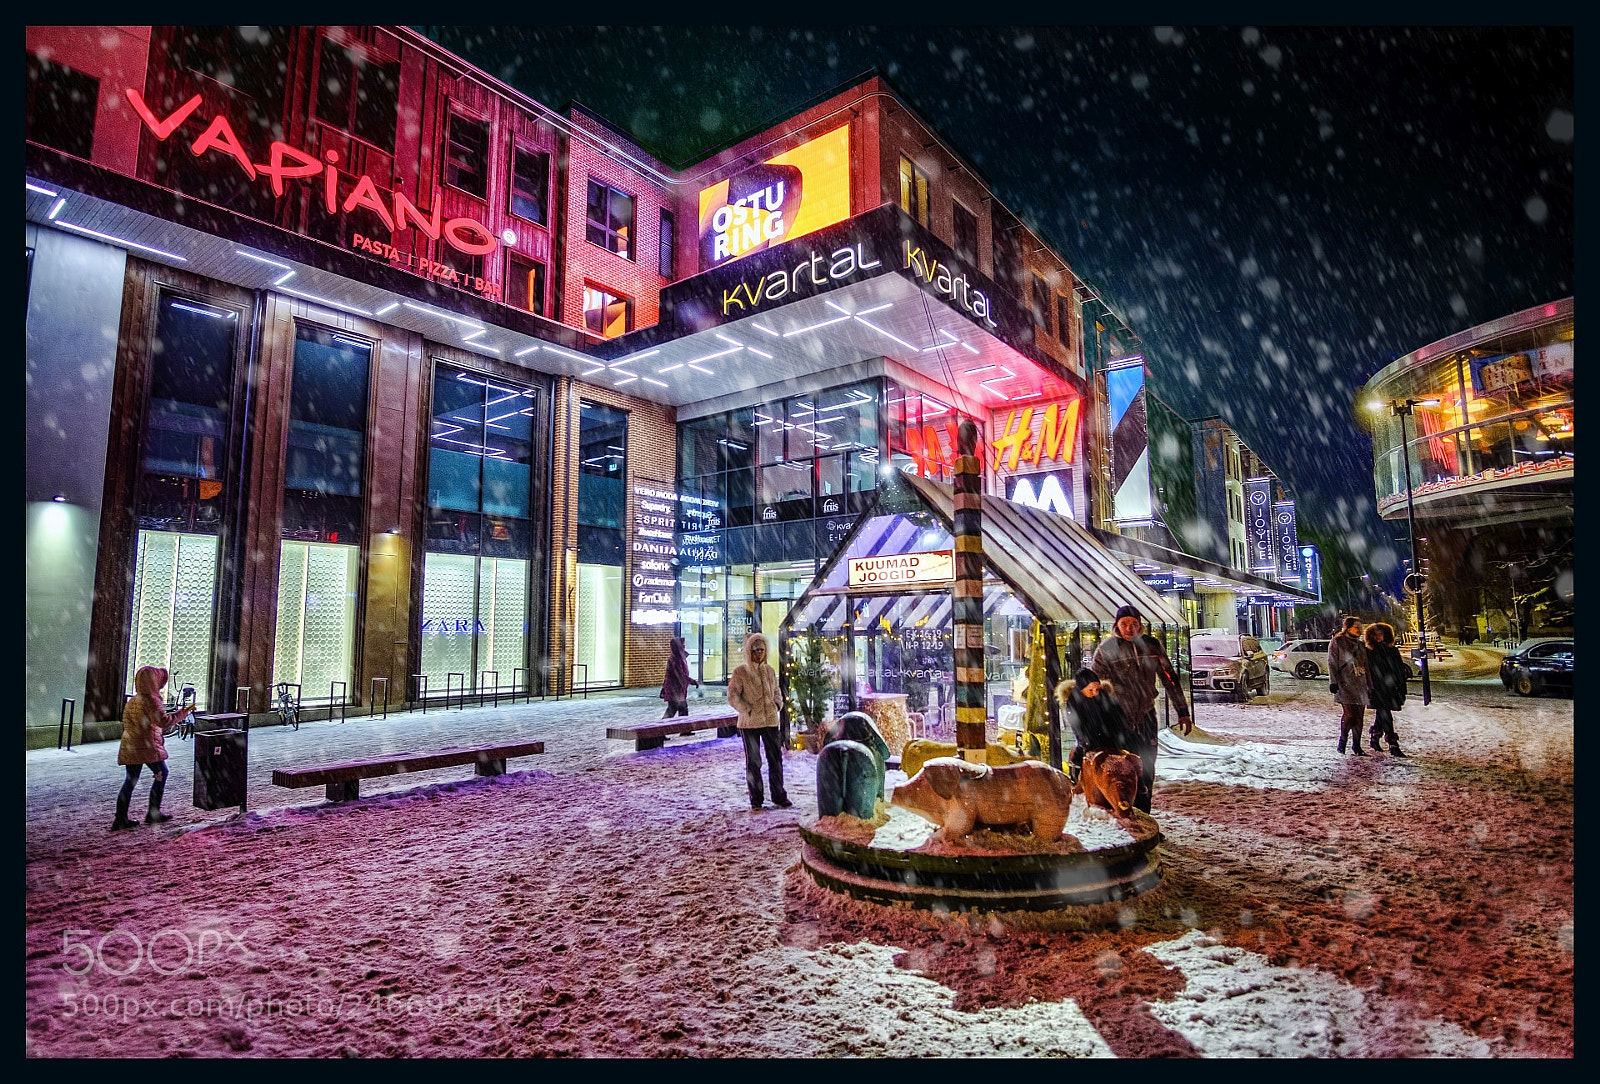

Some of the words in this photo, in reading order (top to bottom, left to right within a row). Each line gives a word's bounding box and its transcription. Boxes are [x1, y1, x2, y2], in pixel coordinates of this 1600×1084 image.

[713, 181, 784, 233] OSTU
[714, 210, 784, 261] RING
[353, 233, 400, 262] PASTA
[419, 257, 458, 283] PIZZA
[475, 277, 501, 297] BAR
[991, 398, 1081, 471] H&M
[635, 514, 675, 527] ESPRIT
[823, 499, 839, 513] friis
[633, 542, 677, 555] DANIJA
[1255, 508, 1267, 560] JOYCE
[1282, 527, 1293, 571] JOYCE
[855, 557, 919, 571] KUUMAD
[859, 569, 916, 582] JOOGID
[421, 618, 488, 634] ZARA
